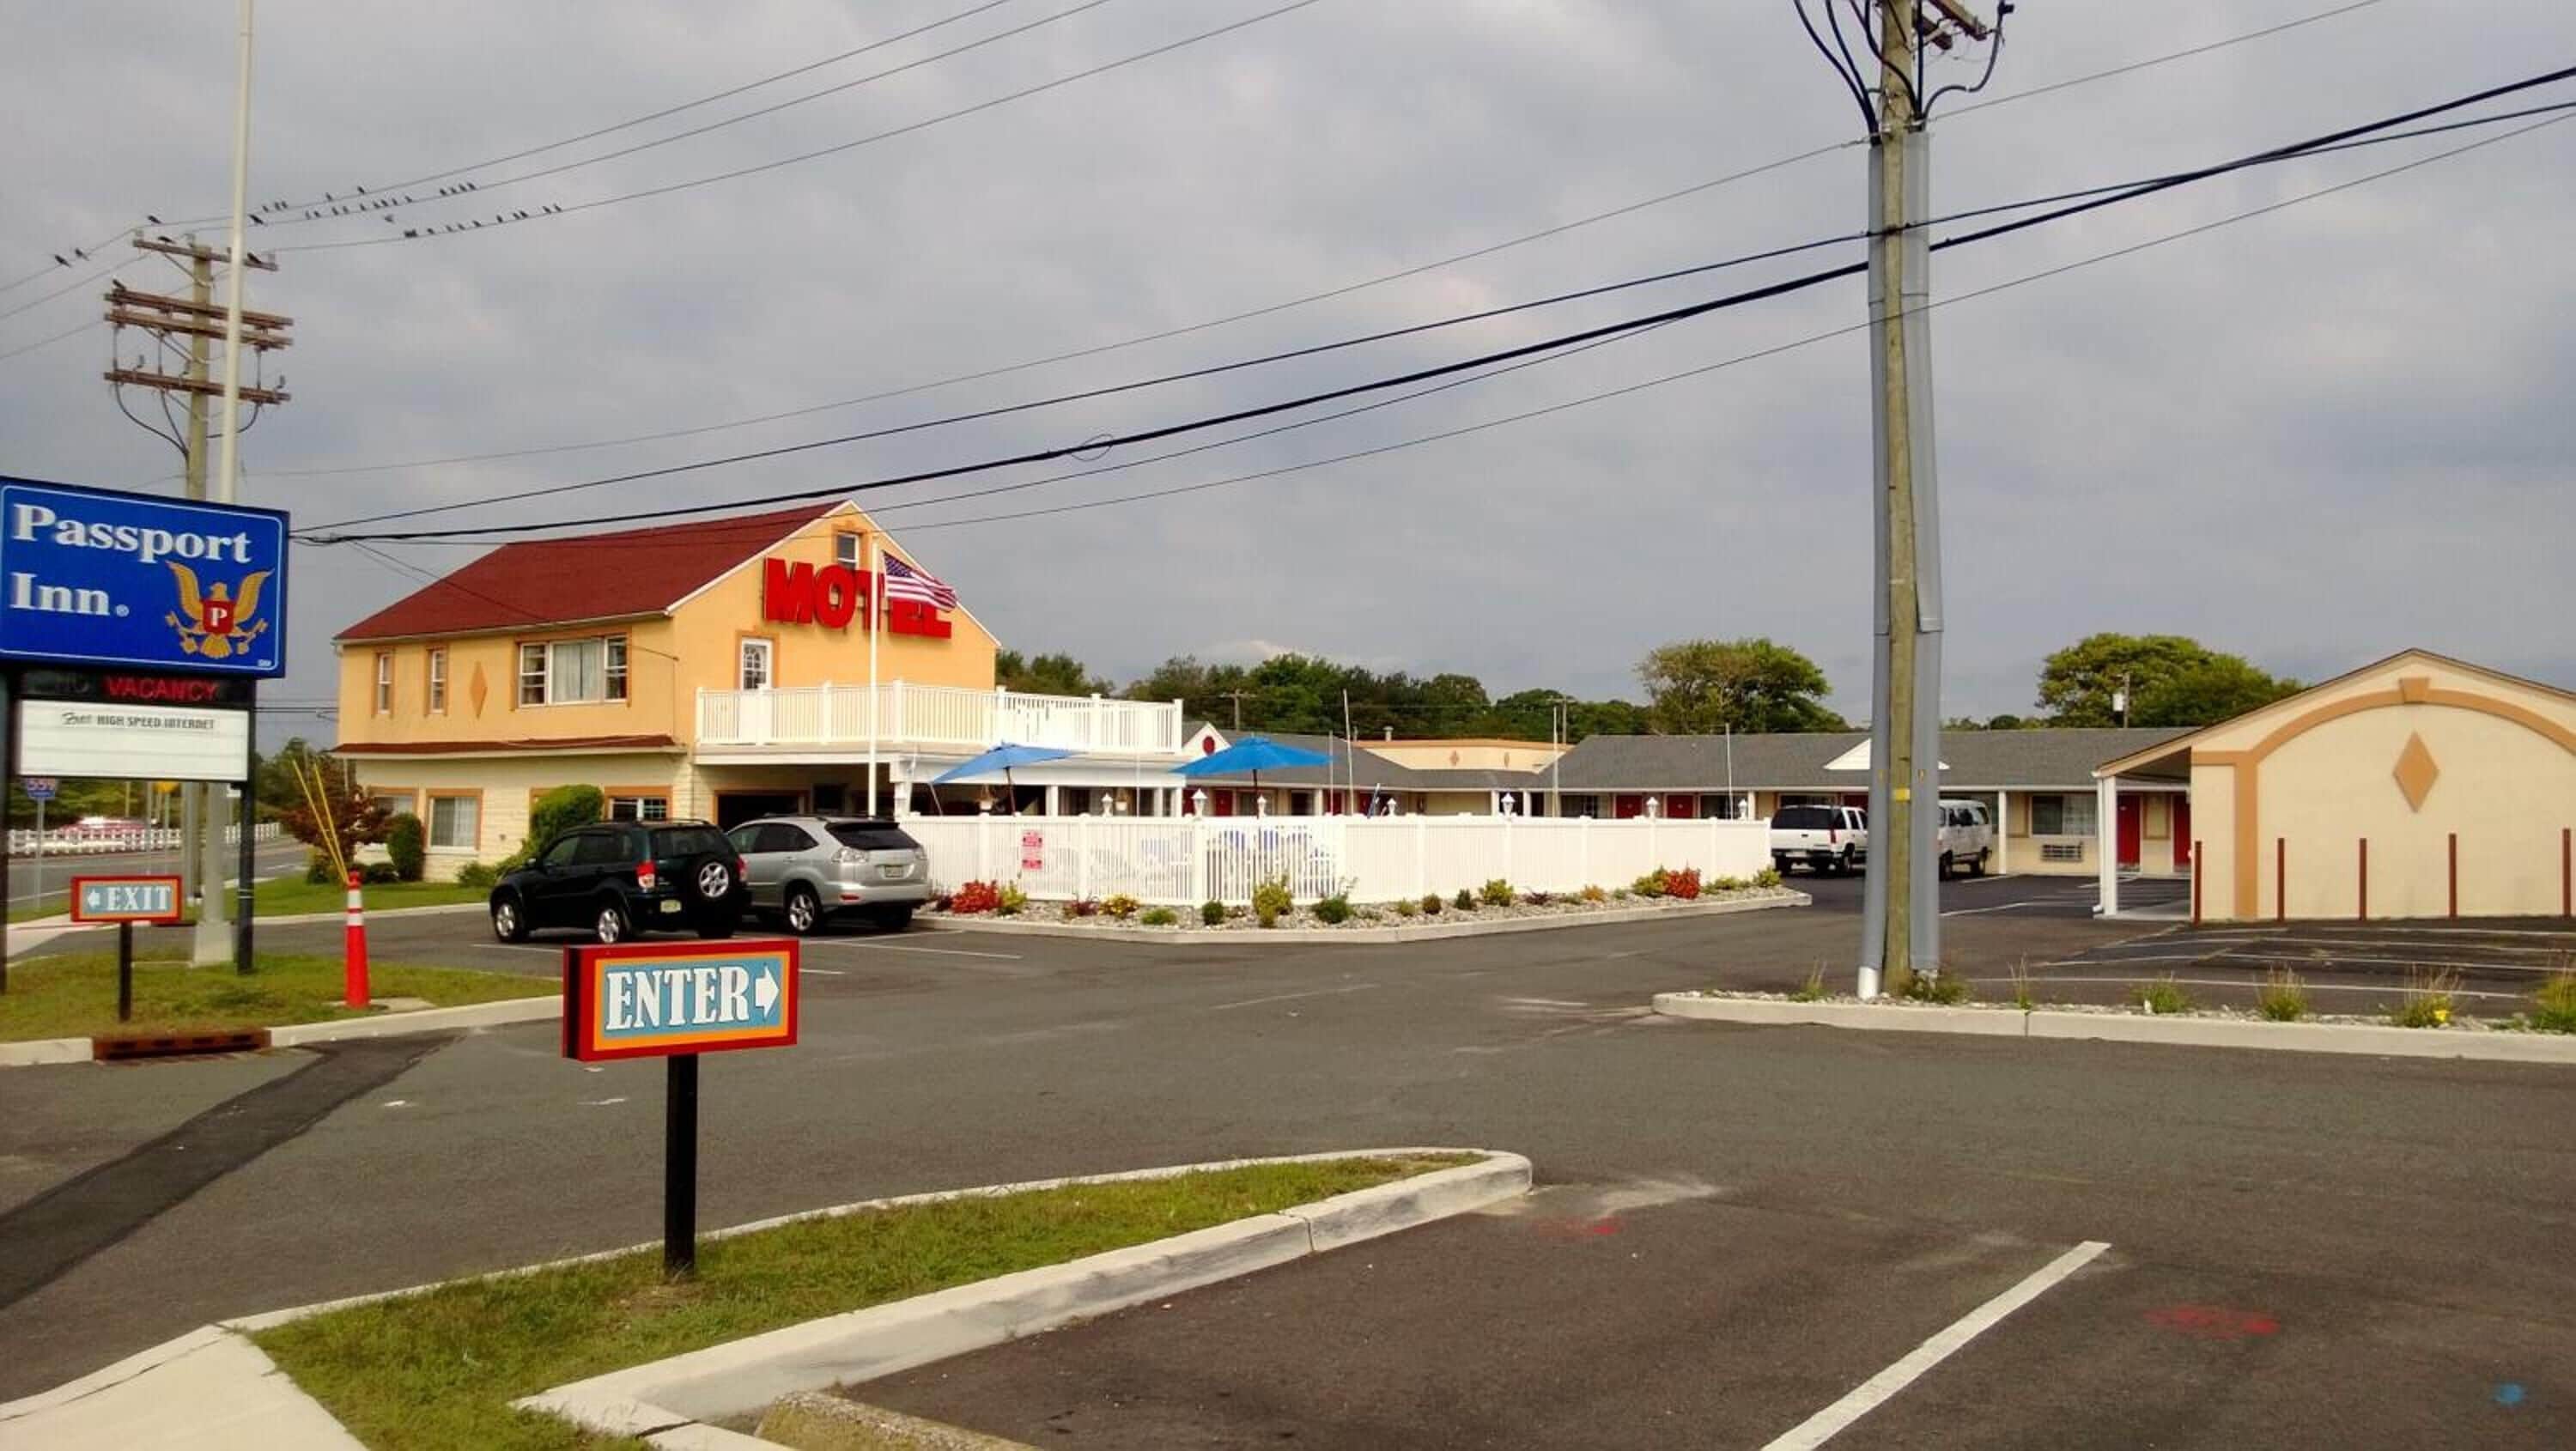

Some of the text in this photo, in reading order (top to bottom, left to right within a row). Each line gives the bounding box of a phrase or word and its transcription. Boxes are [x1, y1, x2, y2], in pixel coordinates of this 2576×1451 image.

[11, 503, 252, 563] Passport
[210, 606, 228, 628] P
[107, 677, 220, 701] VACANCY
[96, 713, 125, 726] HIGH
[128, 716, 161, 728] SPEED
[164, 717, 215, 731] INTERNET
[106, 885, 171, 911] EXIT
[605, 966, 750, 1030] ENTER
